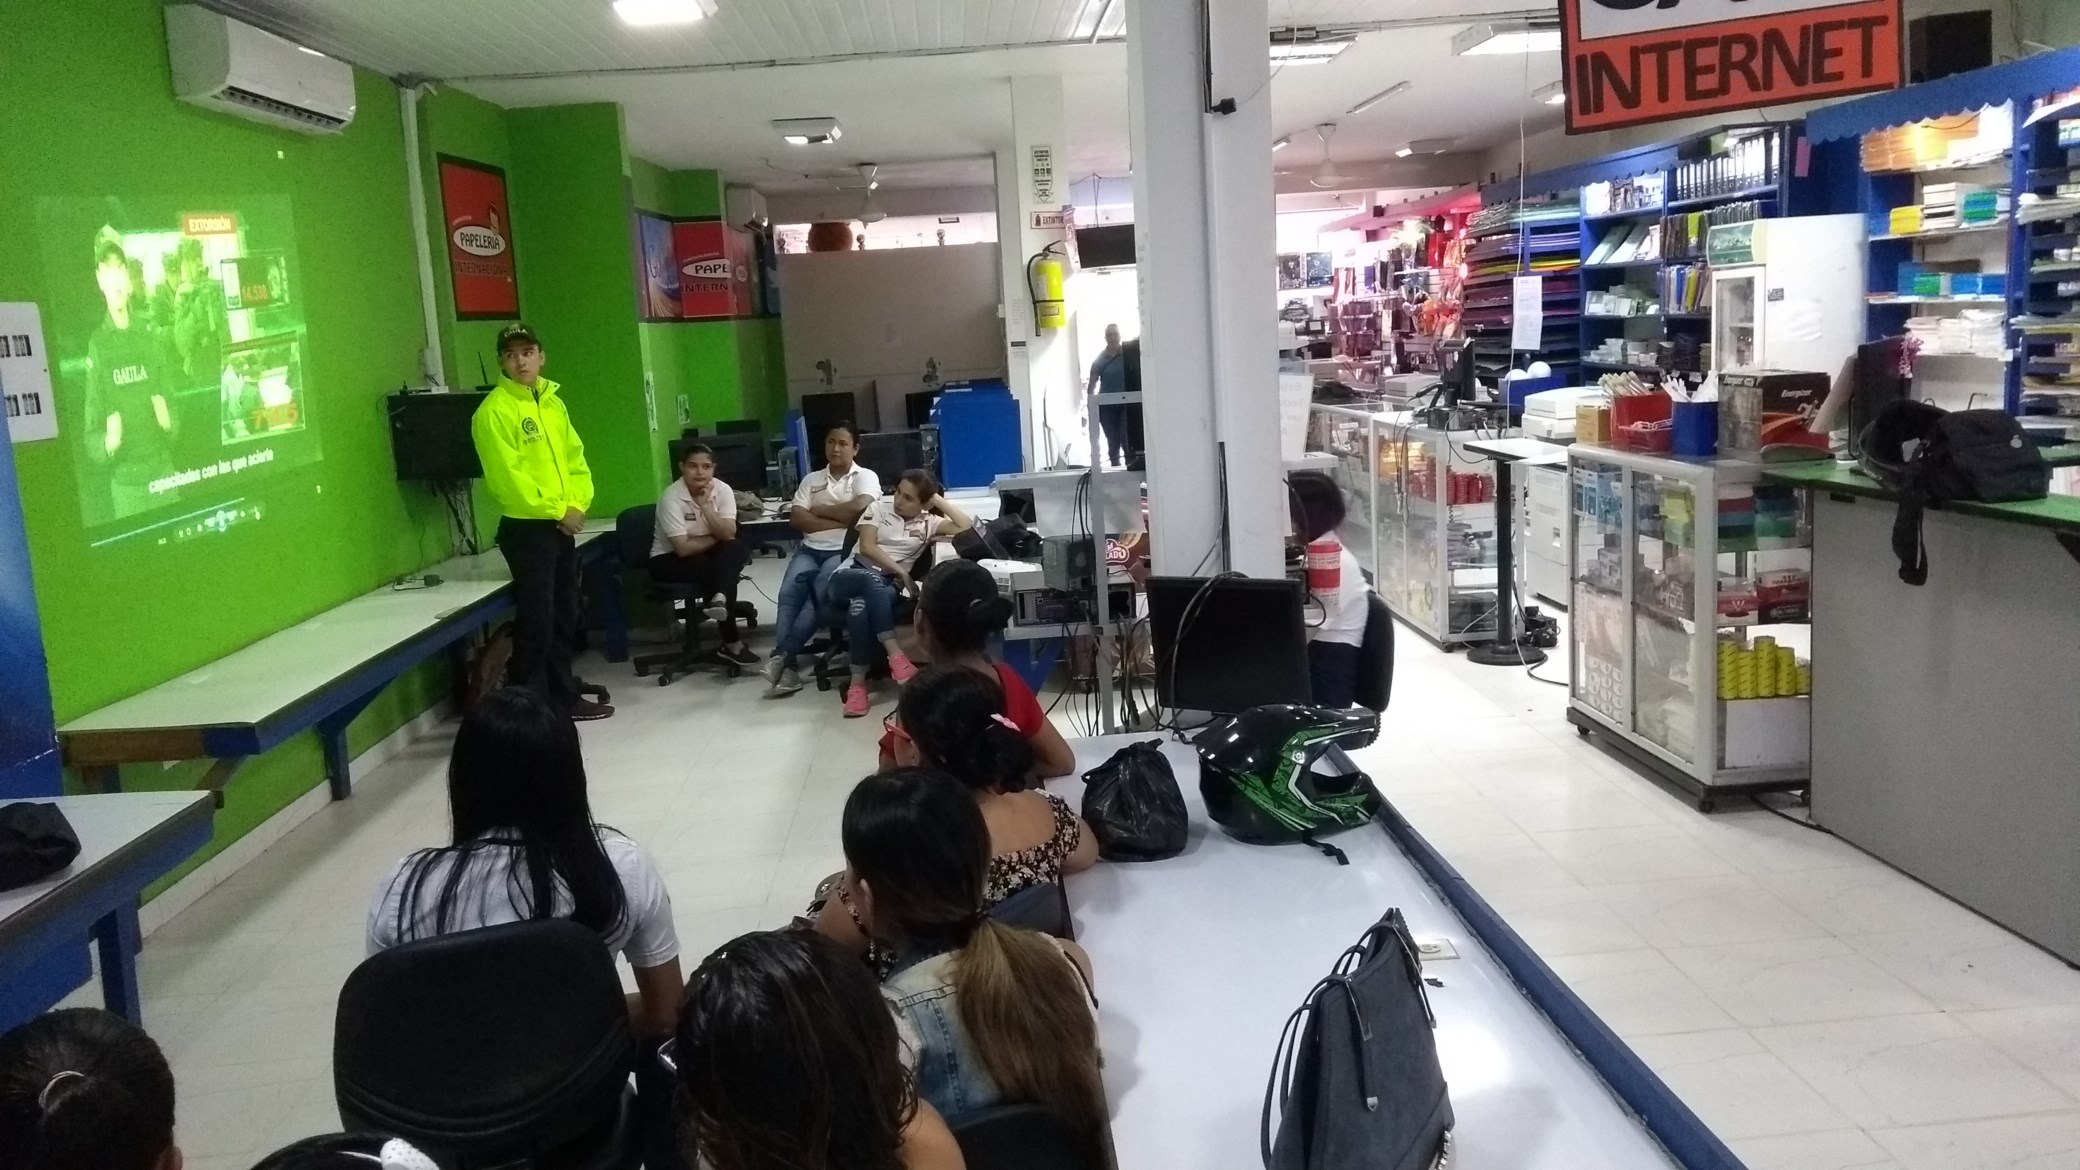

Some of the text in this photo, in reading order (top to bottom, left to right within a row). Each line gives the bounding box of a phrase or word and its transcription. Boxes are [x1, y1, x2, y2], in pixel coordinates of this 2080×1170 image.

[1575, 15, 1889, 116] INTERNET
[460, 232, 501, 250] PAPELERIA
[113, 365, 148, 385] GAULA
[1781, 388, 1812, 399] Energizer
[201, 464, 218, 479] con
